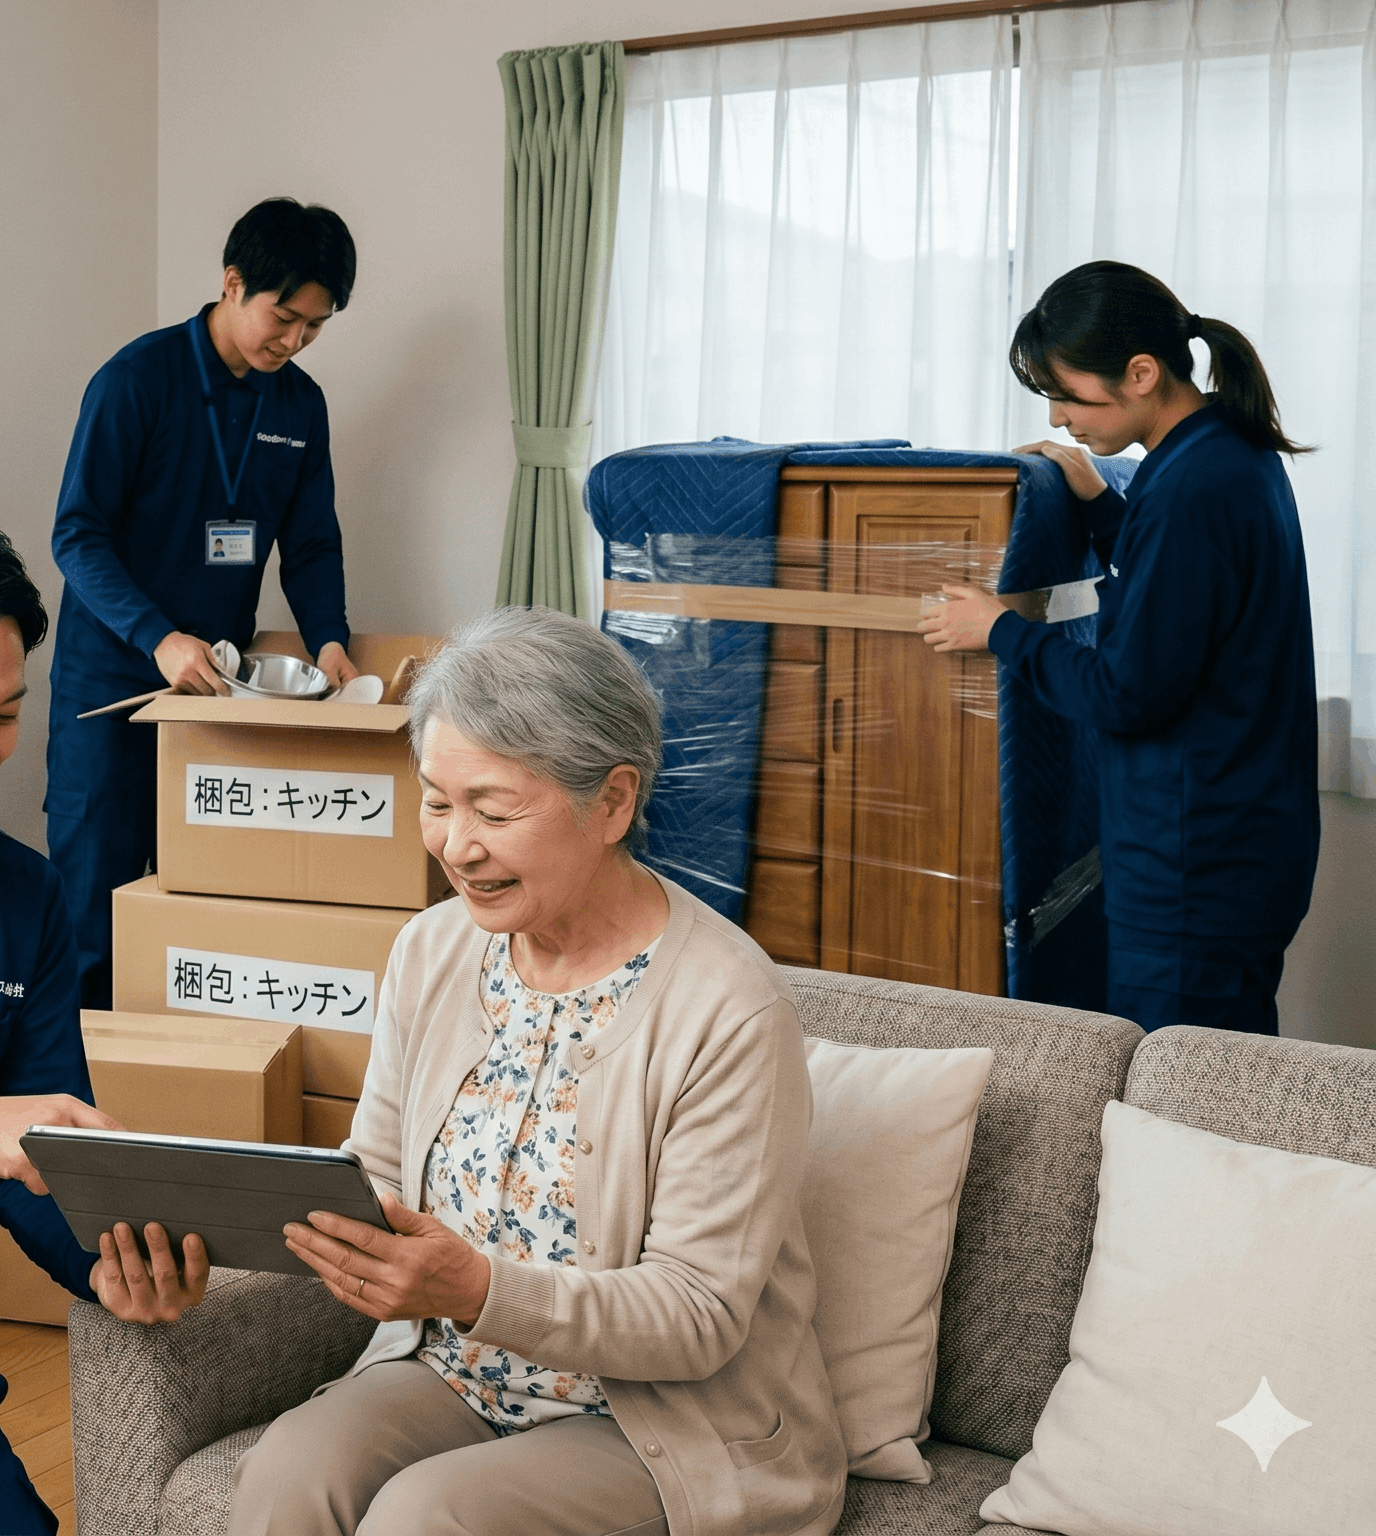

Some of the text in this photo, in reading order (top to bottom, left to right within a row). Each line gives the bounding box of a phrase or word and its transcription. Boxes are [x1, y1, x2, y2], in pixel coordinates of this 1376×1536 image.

[194, 775, 387, 822] 梱包：キッチン
[174, 957, 368, 1017] 梱包：キッチン
